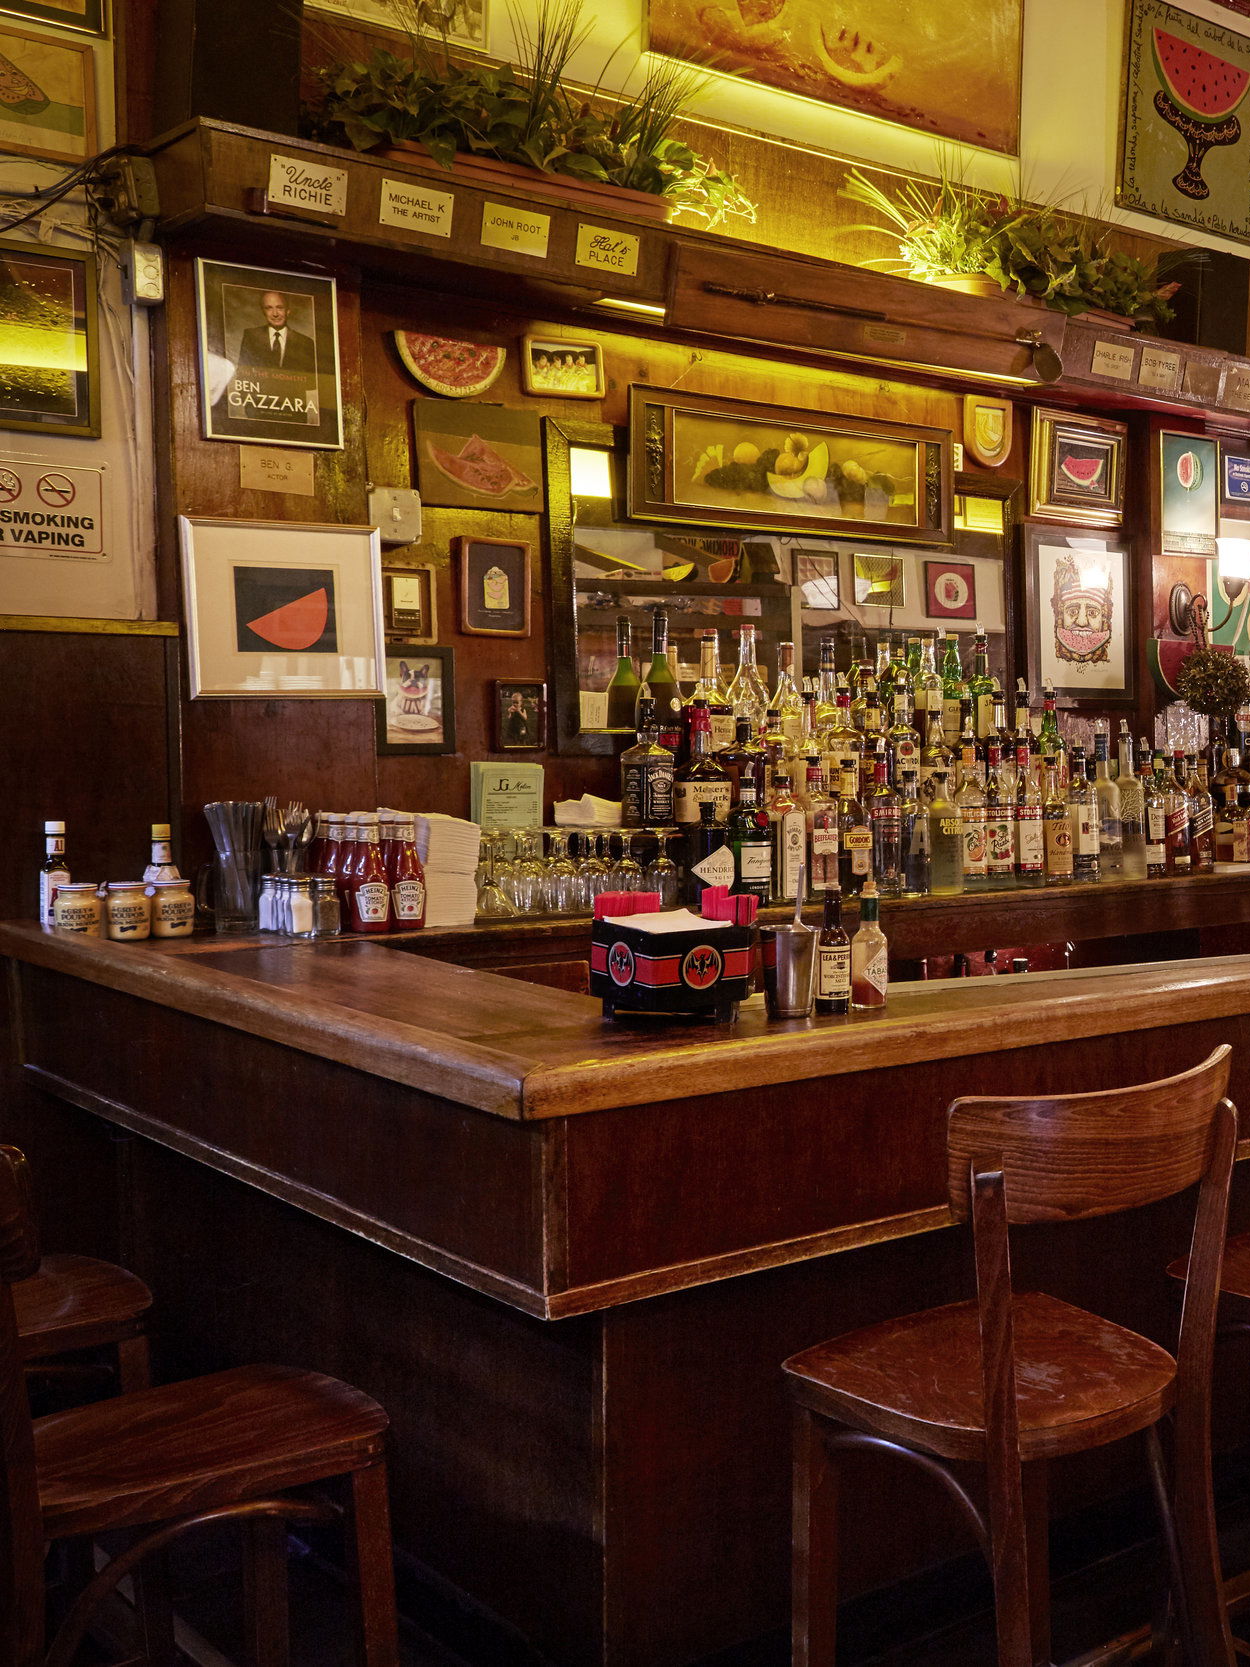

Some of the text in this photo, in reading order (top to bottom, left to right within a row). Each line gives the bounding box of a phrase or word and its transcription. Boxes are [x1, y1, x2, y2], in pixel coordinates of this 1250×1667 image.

[1187, 19, 1200, 37] del
[283, 184, 333, 207] RICHIE
[388, 192, 446, 214] MICHAEL K
[1127, 193, 1147, 209] Oda
[1151, 204, 1157, 212] a
[1160, 199, 1169, 216] la
[392, 206, 441, 224] THE ARTIST
[490, 216, 542, 235] JOHN ROOT
[589, 234, 631, 256] Hal's
[588, 250, 625, 268] PLACE
[1095, 350, 1117, 362] CHARLIE
[1144, 357, 1176, 372] BOB TYREE
[234, 379, 261, 393] BEN
[228, 391, 319, 414] GAZZARA
[260, 459, 280, 470] BEN
[0, 509, 94, 531] SMOKING
[10, 527, 85, 548] VAPING
[365, 887, 384, 895] HEINZ
[400, 885, 419, 893] HEINZ
[61, 913, 96, 921] POUPON
[110, 911, 145, 919] POUPON
[161, 907, 193, 916] POUPON
